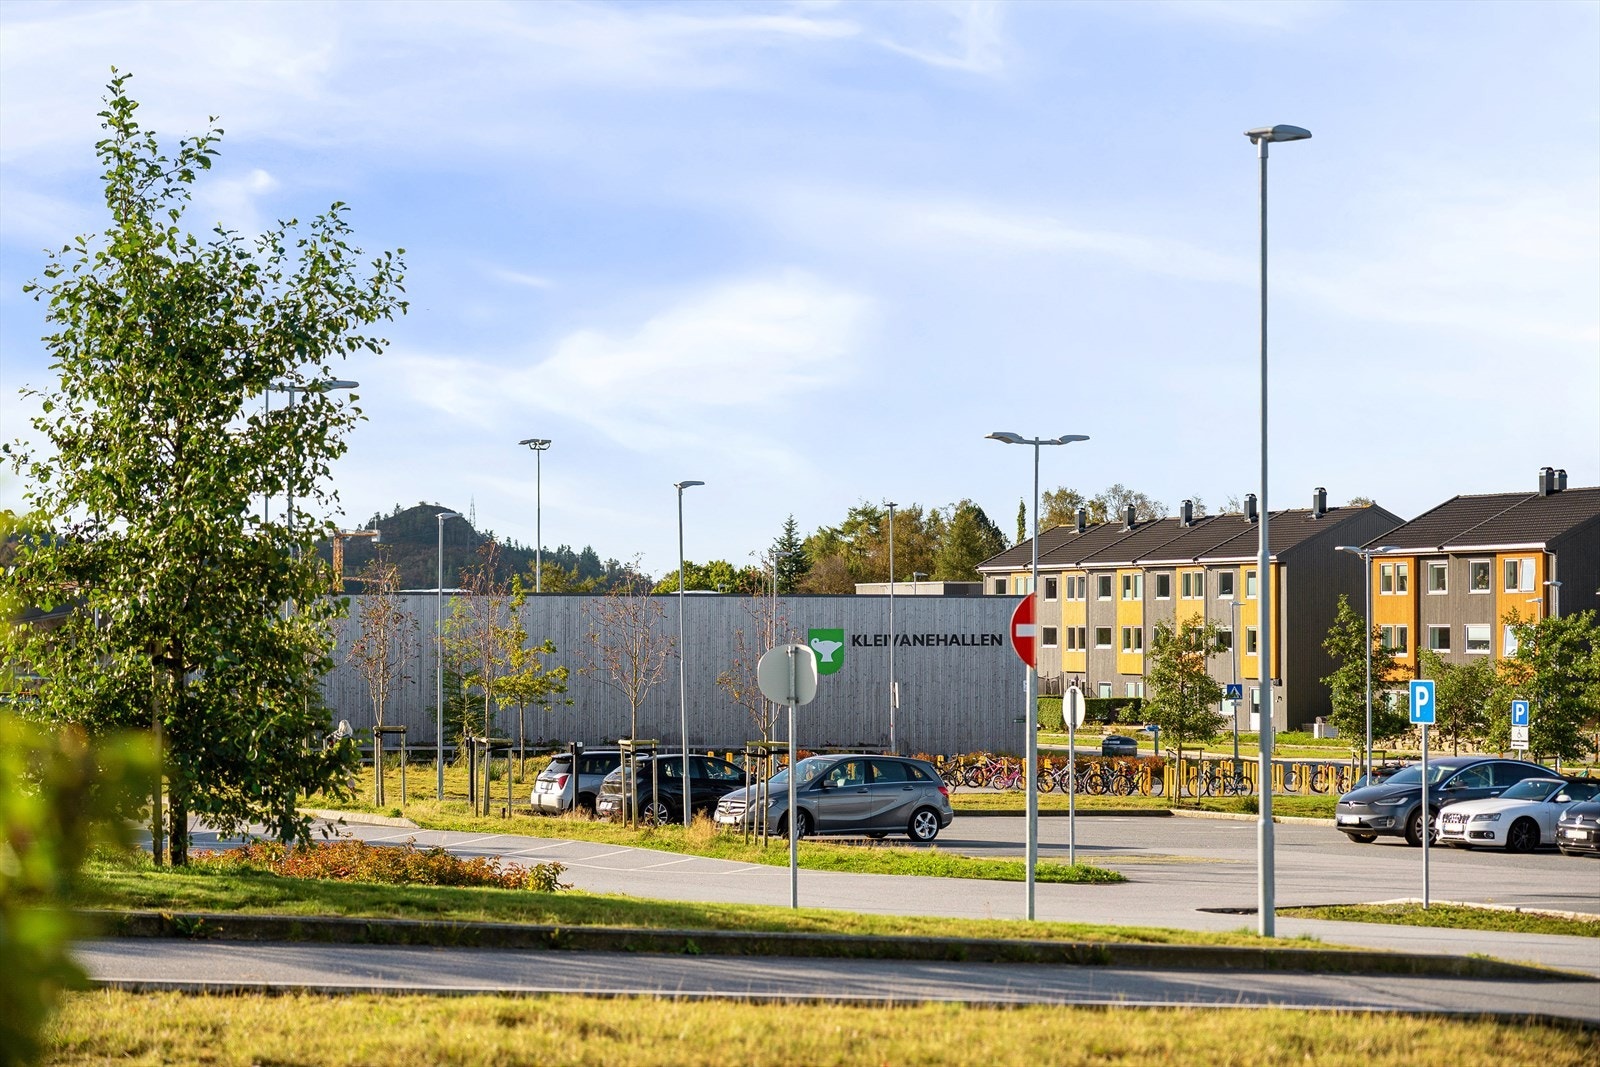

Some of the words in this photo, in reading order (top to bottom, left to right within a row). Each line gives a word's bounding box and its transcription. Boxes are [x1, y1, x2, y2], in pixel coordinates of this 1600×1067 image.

[851, 633, 1003, 647] KLEIVANEHALLEN
[1415, 685, 1430, 718] P
[1515, 703, 1525, 723] P
